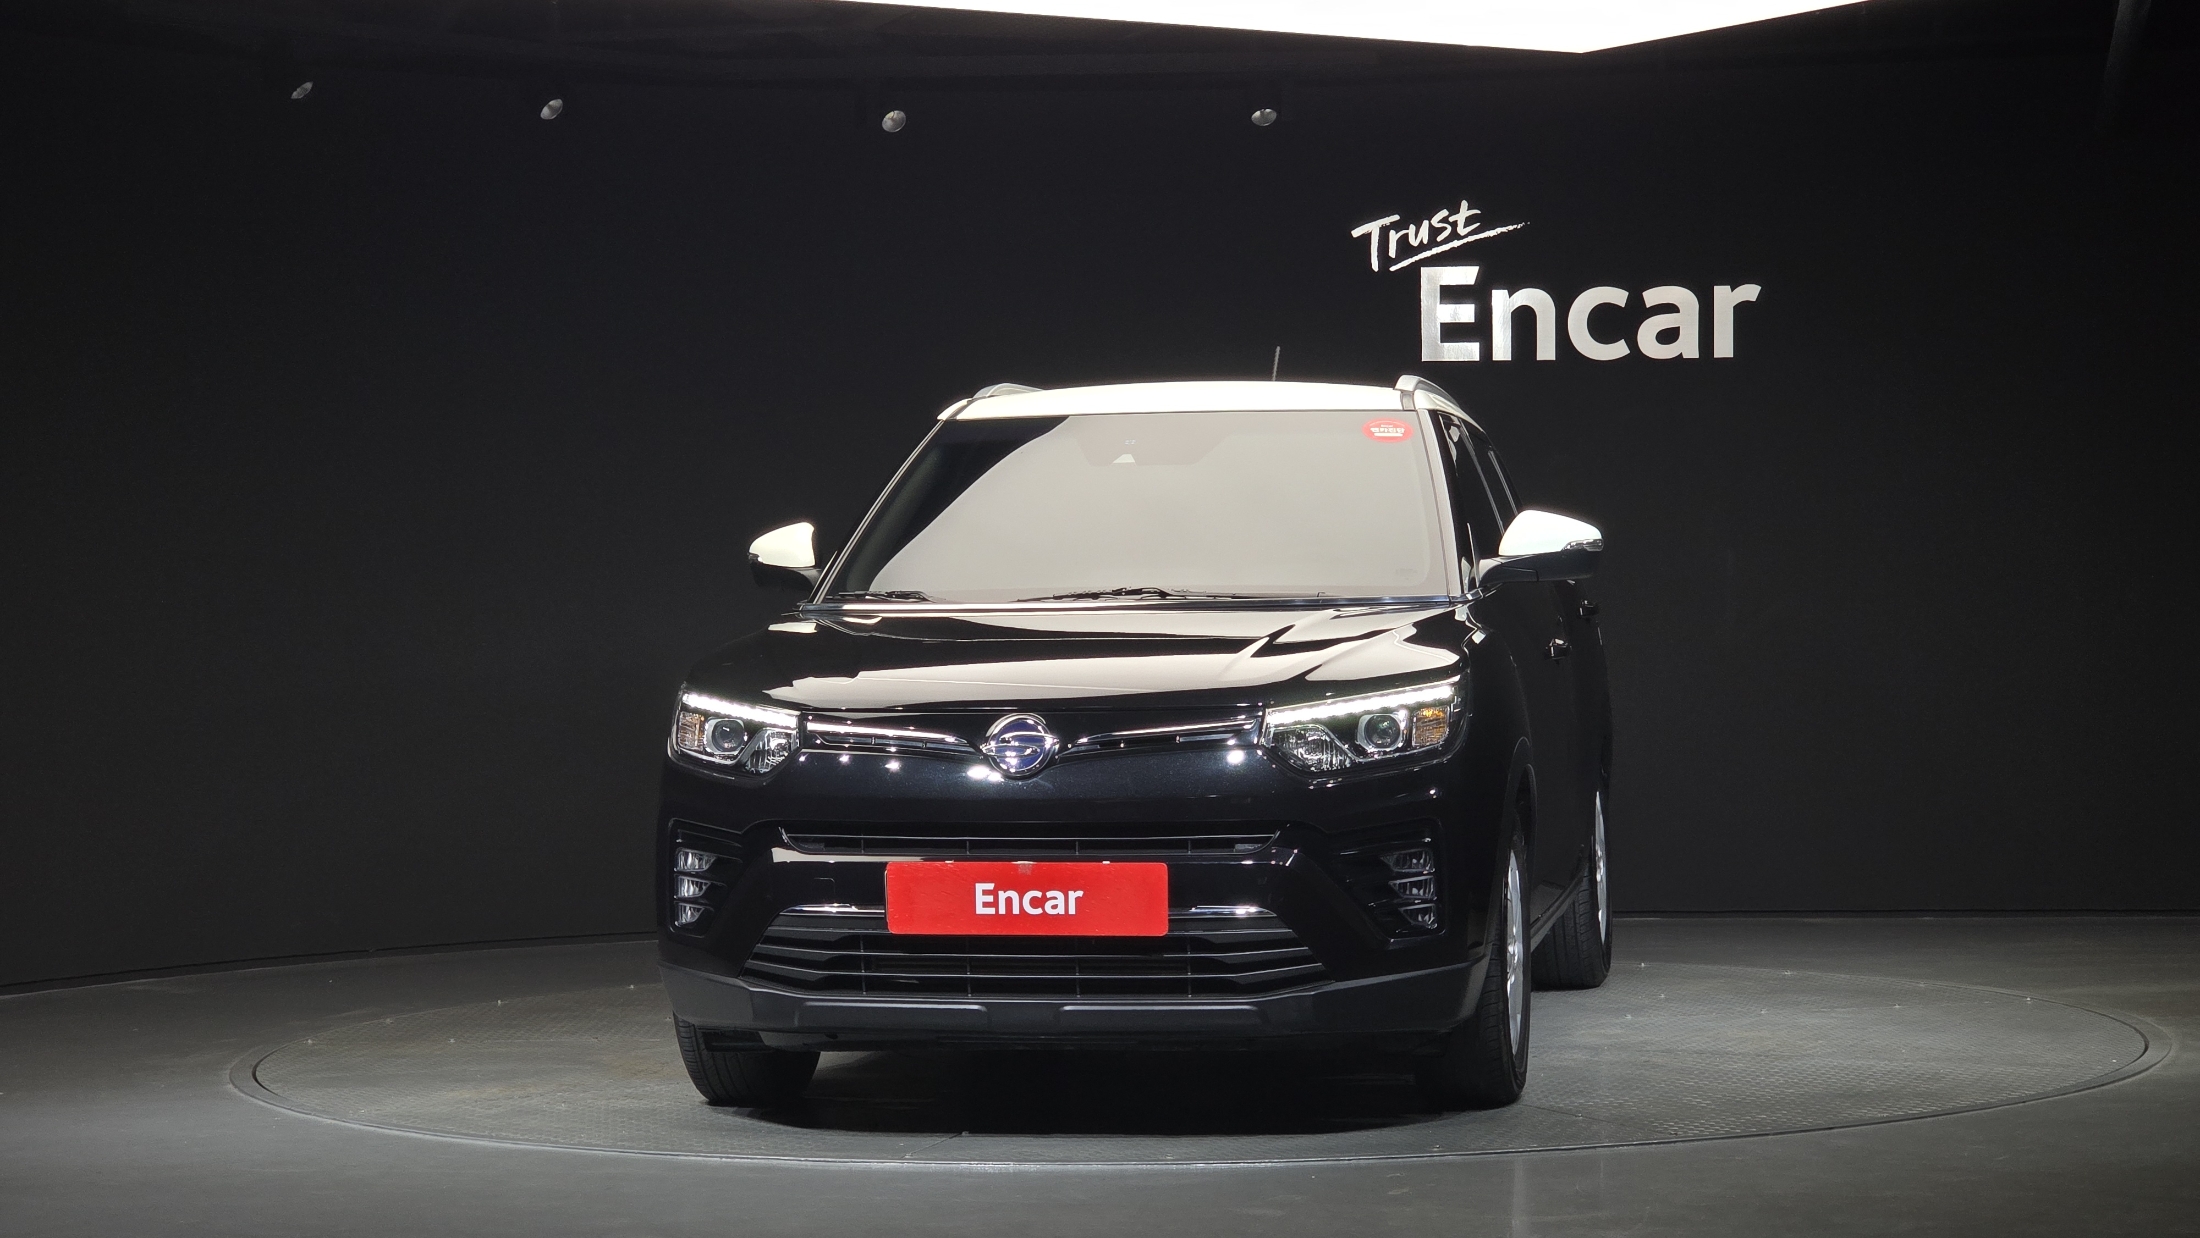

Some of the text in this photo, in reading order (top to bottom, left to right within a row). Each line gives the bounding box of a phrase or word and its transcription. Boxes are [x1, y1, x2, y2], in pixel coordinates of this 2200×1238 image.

[1351, 200, 1481, 272] Trust
[1420, 265, 1762, 362] Encar
[974, 882, 1083, 915] Encar
